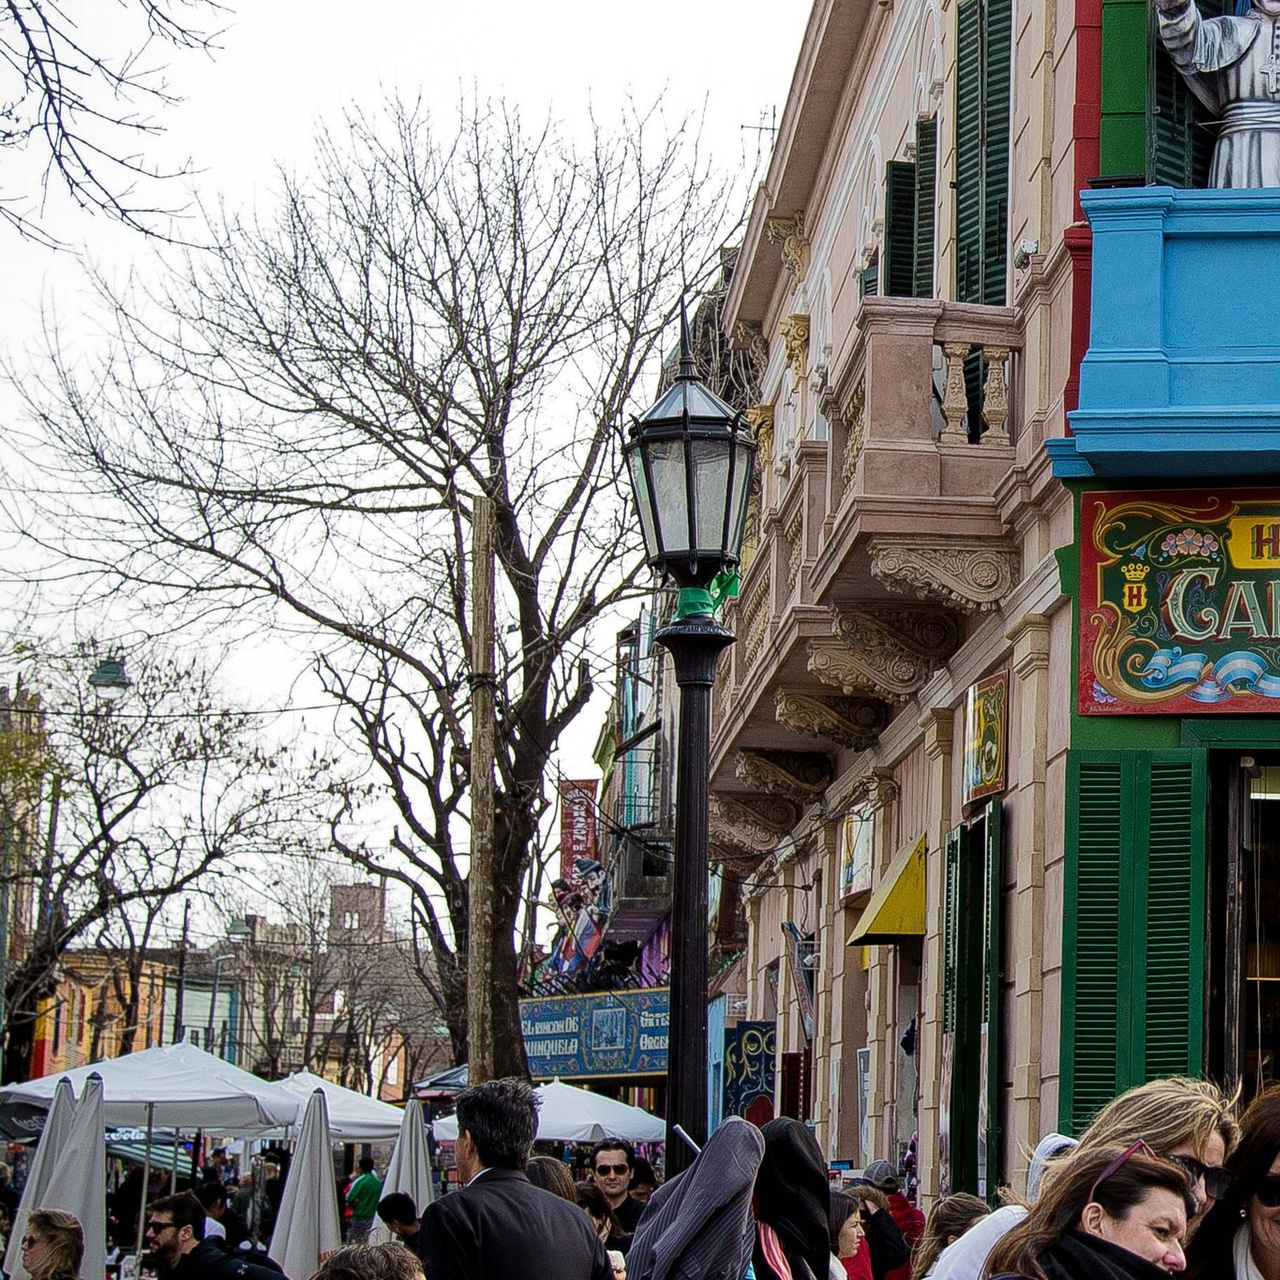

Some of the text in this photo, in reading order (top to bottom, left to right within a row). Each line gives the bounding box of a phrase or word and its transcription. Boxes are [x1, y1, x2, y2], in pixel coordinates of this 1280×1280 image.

[1127, 585, 1143, 607] H
[521, 1016, 579, 1036] EL RINCON DE
[524, 1038, 579, 1060] UINQUELA
